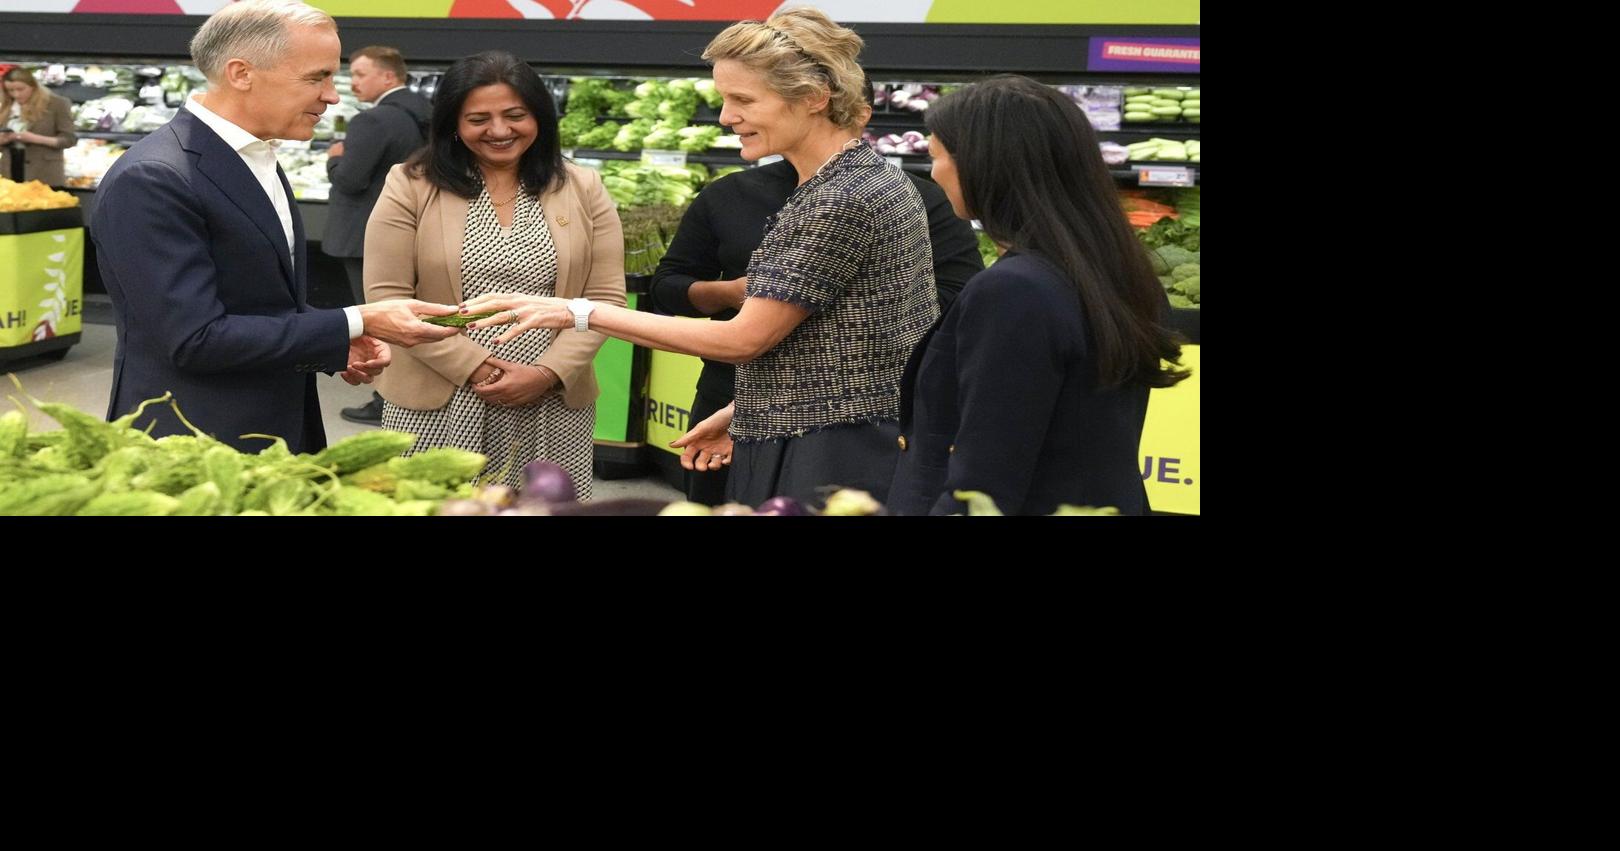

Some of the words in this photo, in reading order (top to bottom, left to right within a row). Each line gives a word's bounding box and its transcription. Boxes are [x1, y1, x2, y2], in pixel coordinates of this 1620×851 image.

[1107, 45, 1142, 56] FRESH
[1143, 47, 1199, 59] GUARANTE
[647, 398, 690, 431] RIET
